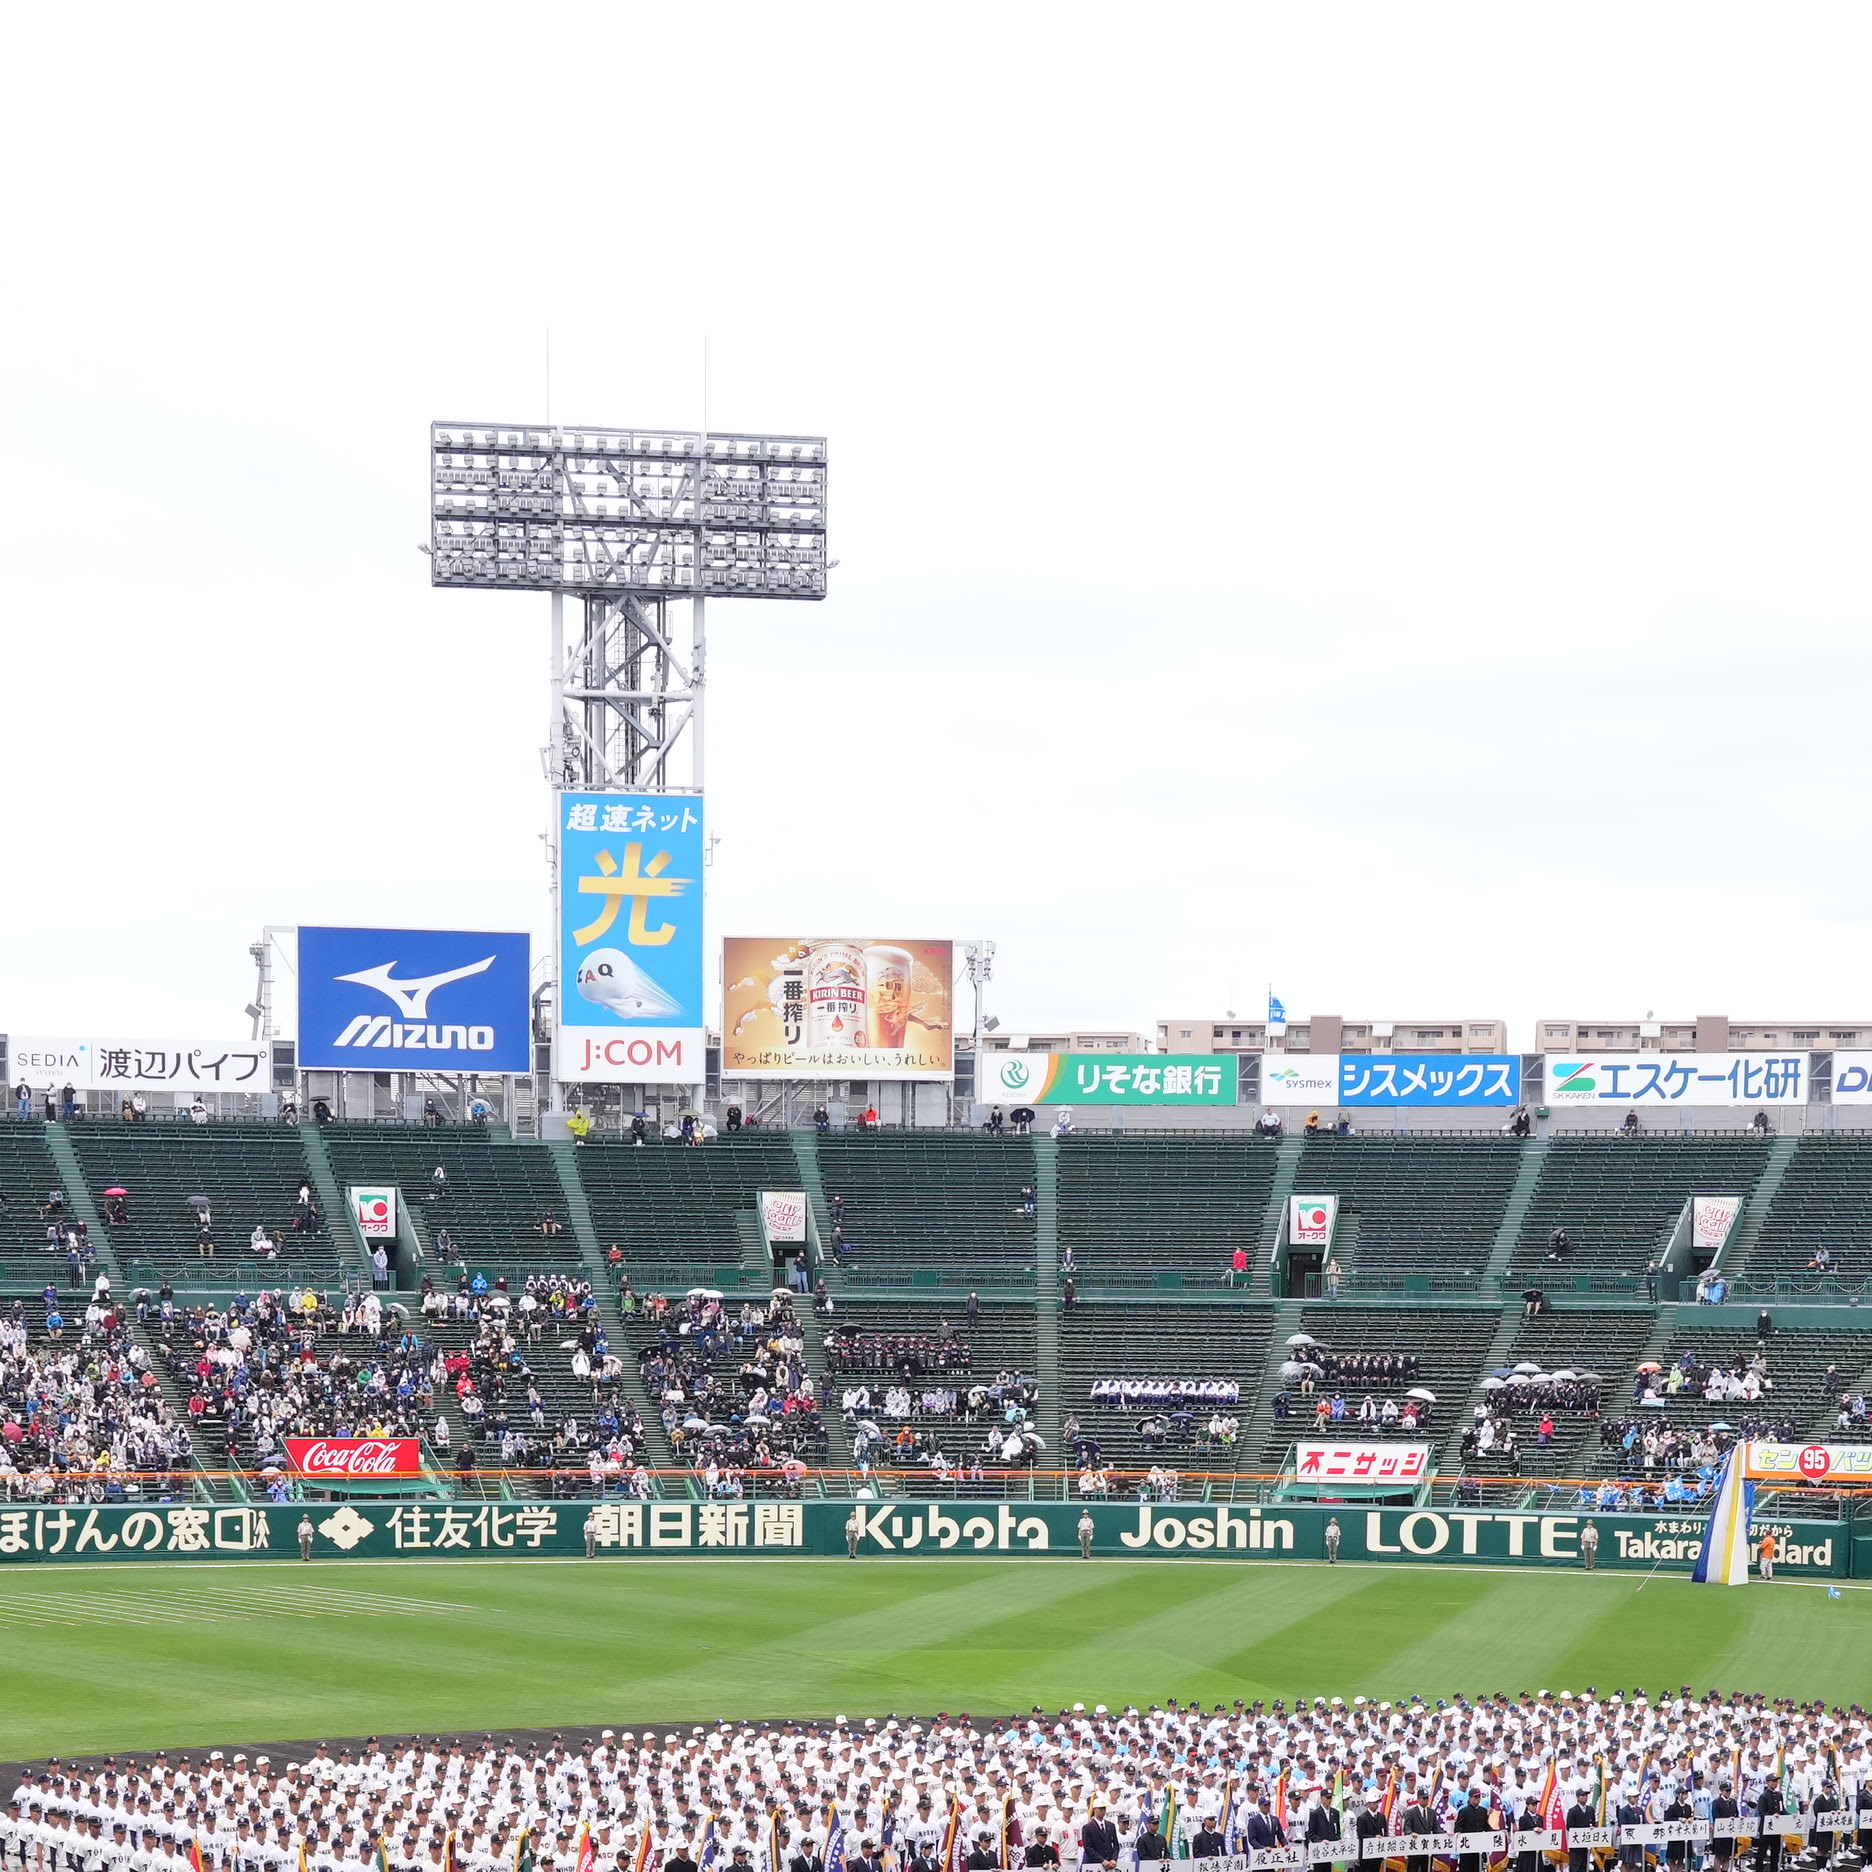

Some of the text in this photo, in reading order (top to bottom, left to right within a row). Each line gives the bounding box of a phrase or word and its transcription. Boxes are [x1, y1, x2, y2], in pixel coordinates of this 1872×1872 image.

[566, 803, 698, 833] 超速ネット
[571, 841, 697, 947] 光
[783, 969, 803, 1045] 一番搾り
[812, 988, 864, 1001] KIRIN BEER
[817, 1001, 857, 1014] 一番搾り
[99, 1048, 268, 1081] 渡辺パイプ
[580, 1038, 683, 1071] J:COM
[732, 1052, 947, 1068] やっぱりビールはおいしい、うれしい。
[1075, 1061, 1223, 1096] りそな銀行
[1285, 1078, 1333, 1092] sysmex
[1343, 1063, 1514, 1098] シスメックス
[1598, 1059, 1801, 1098] エスケー化研
[1298, 1232, 1326, 1240] オークワ
[302, 1439, 403, 1475] Coca-Cola
[1301, 1448, 1427, 1479] 不二サッシ
[1802, 1450, 1826, 1470] 95
[386, 1506, 558, 1550] 住友化学
[593, 1504, 804, 1548] 朝日新聞
[858, 1504, 1049, 1550] Kubota
[1120, 1506, 1295, 1551] Joshin
[1366, 1512, 1580, 1558] LOTTE
[1614, 1530, 1703, 1559] Takara
[1571, 1831, 1610, 1845] 大垣日大
